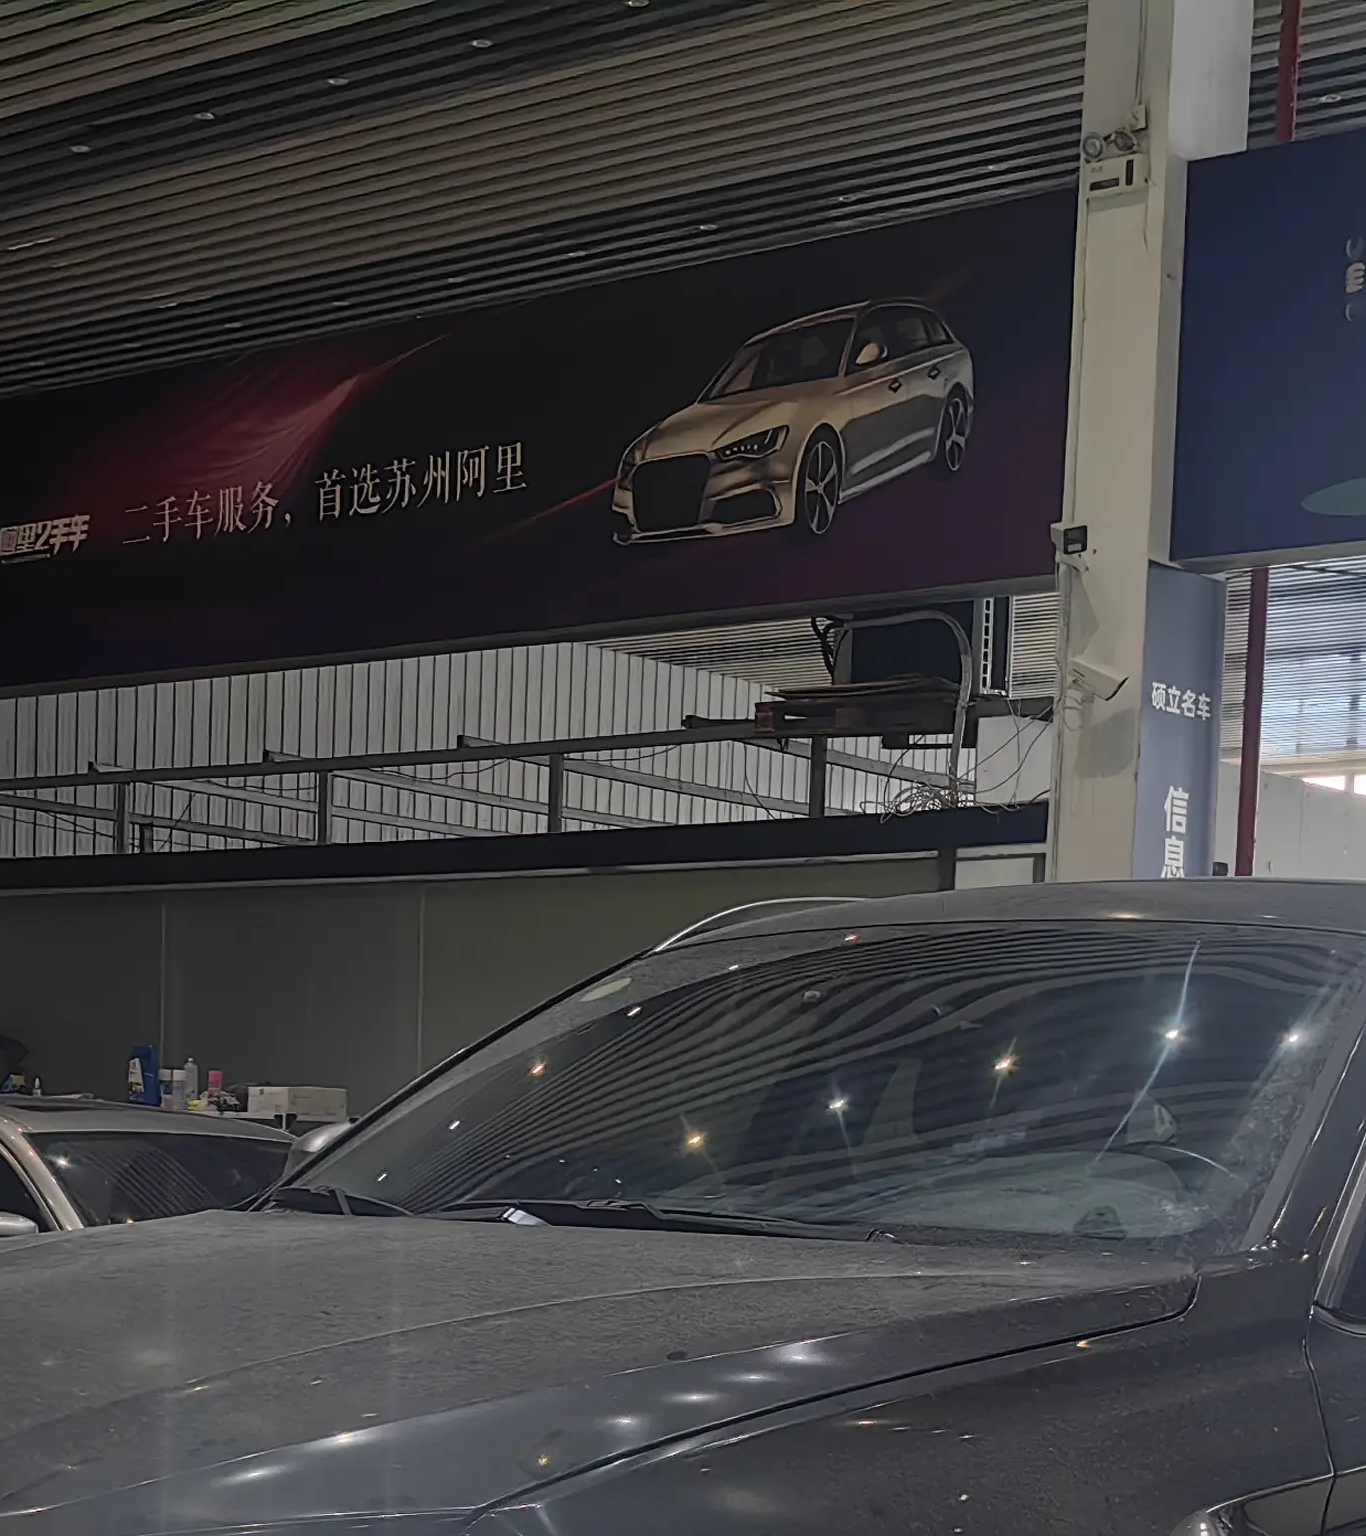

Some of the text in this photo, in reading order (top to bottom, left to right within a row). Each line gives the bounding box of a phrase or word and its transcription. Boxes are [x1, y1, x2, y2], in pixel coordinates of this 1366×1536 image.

[122, 441, 527, 545] 二手车服务，首选苏州阿里
[1151, 681, 1211, 721] 硕立名车
[1160, 785, 1189, 878] 信息
